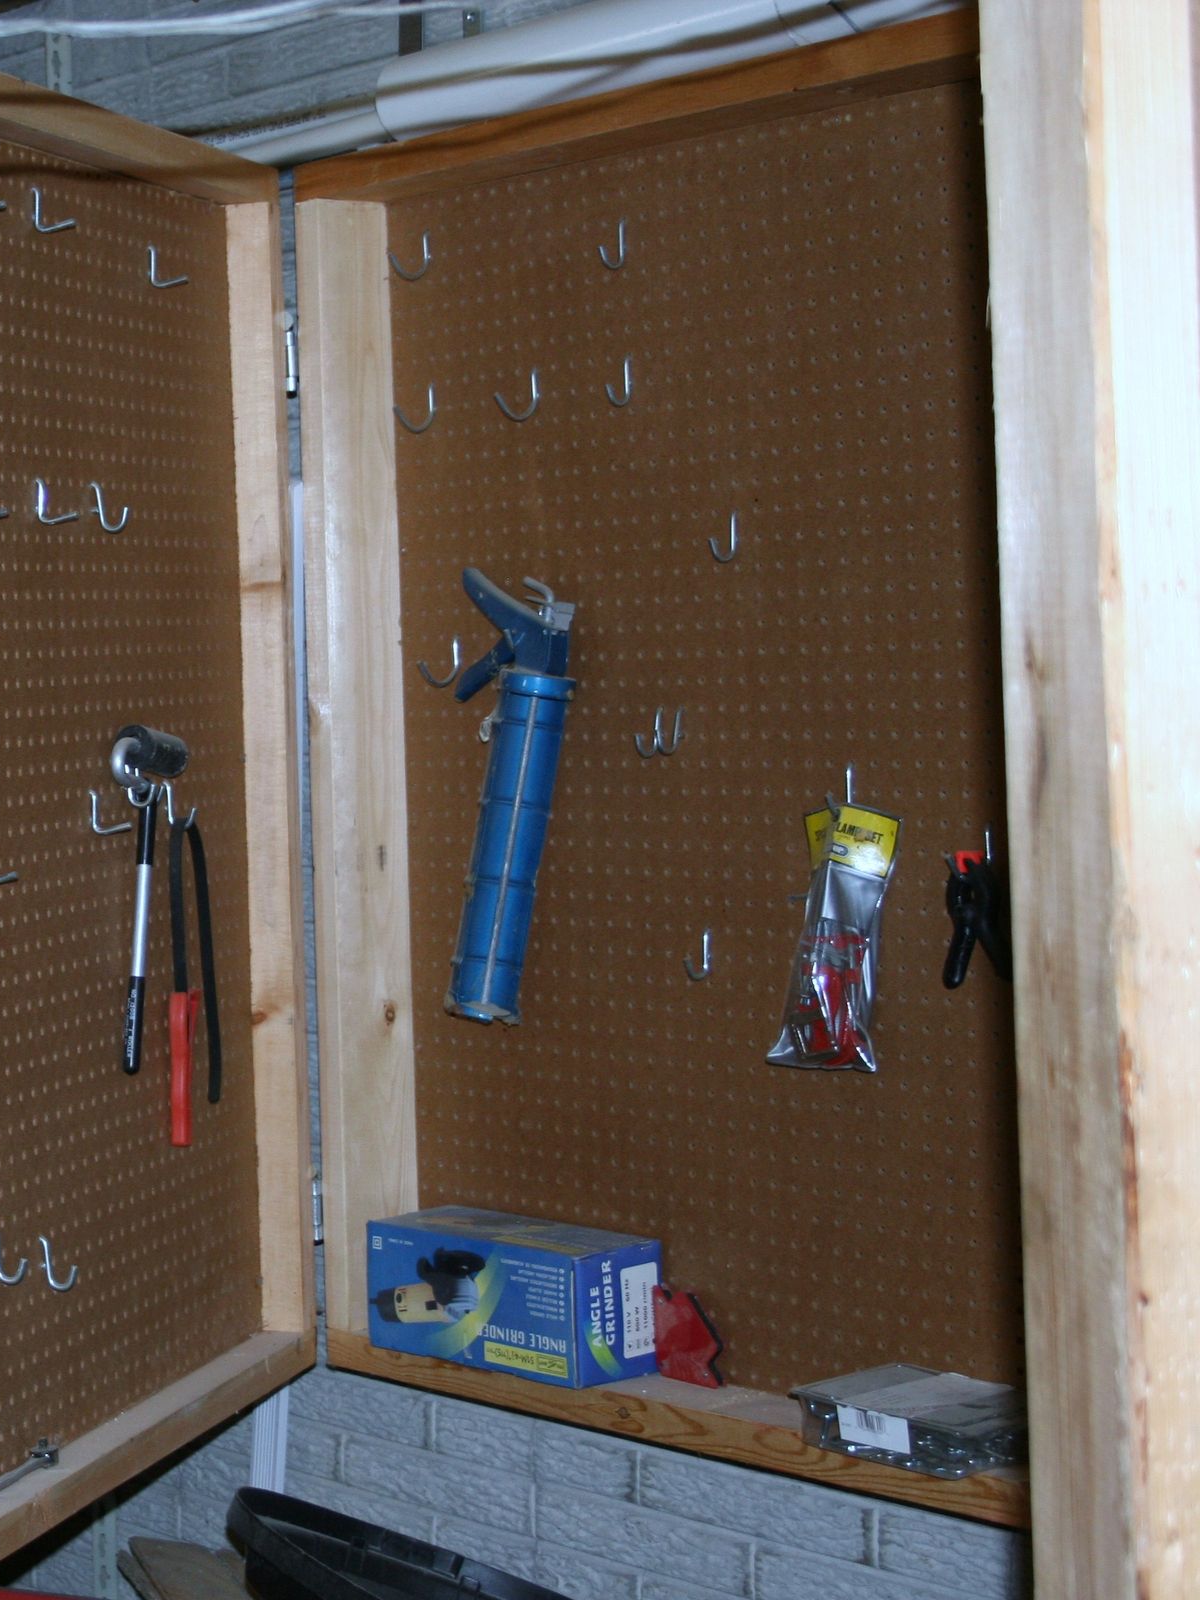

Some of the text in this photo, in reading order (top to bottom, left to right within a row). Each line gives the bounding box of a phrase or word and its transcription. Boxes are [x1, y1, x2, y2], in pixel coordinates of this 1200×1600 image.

[589, 1285, 602, 1348] ANGLE
[601, 1259, 616, 1346] GRINDER
[529, 1333, 567, 1354] ANGLE
